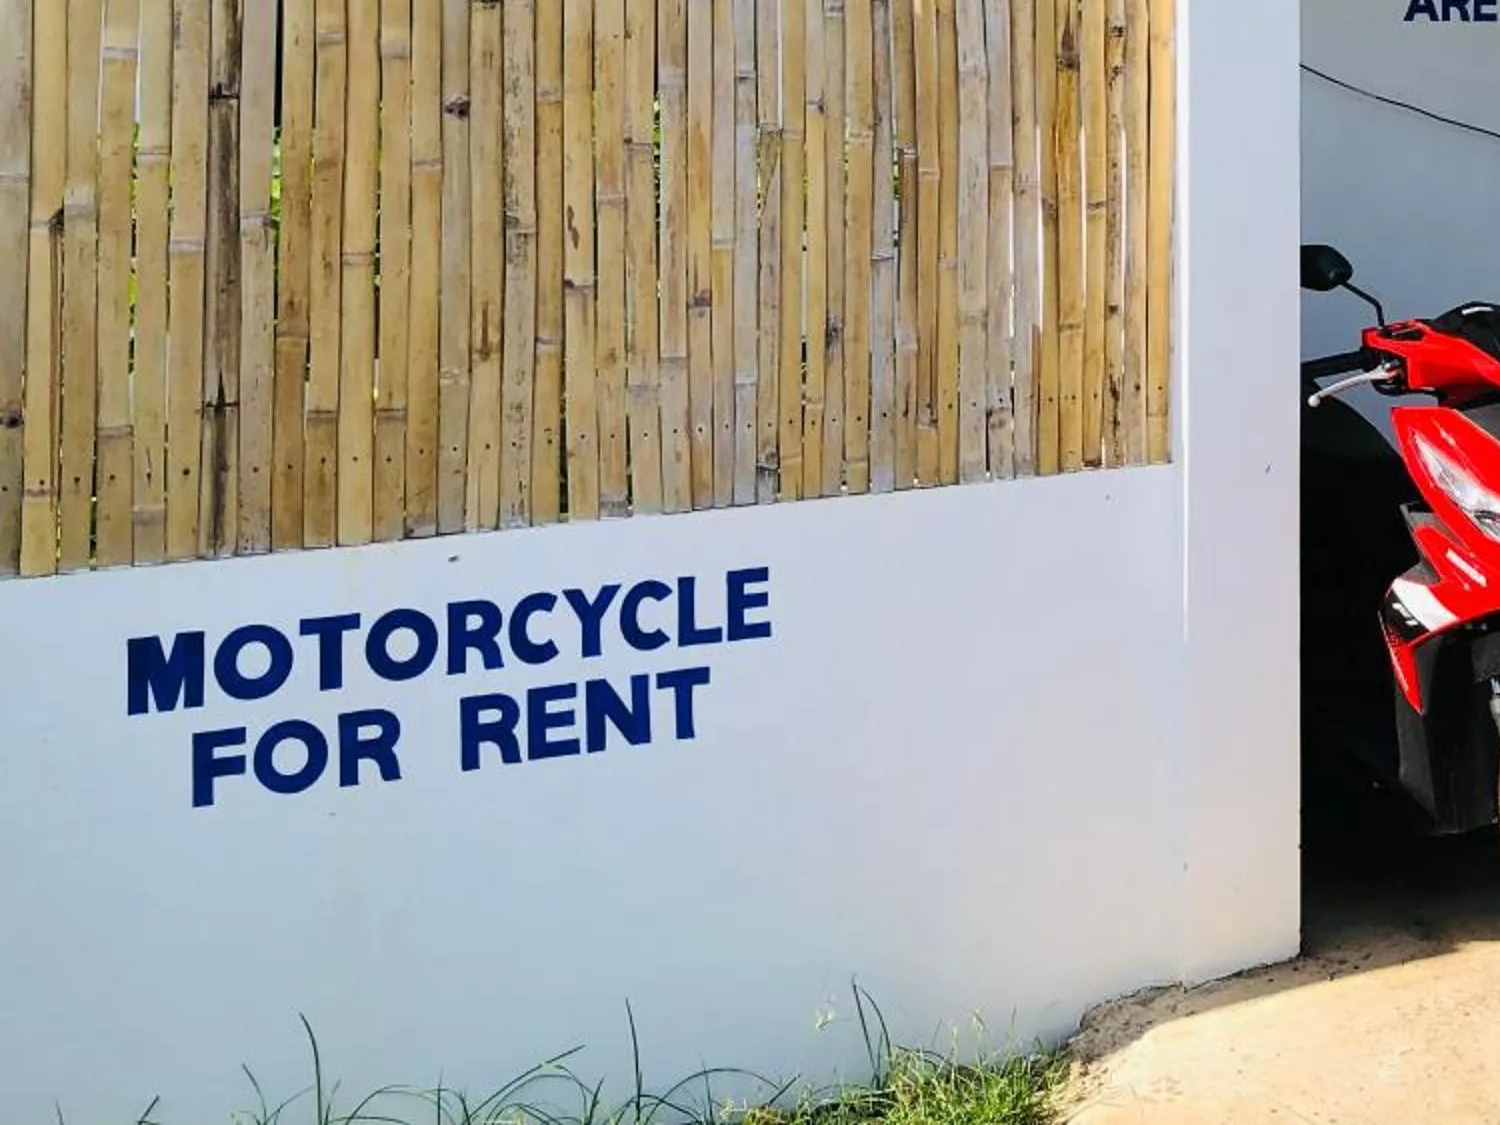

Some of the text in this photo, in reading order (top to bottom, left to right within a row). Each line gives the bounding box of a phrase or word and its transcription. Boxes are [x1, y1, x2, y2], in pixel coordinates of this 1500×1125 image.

[127, 567, 772, 716] MOTORCYCLE
[191, 666, 710, 808] FOR RENT
